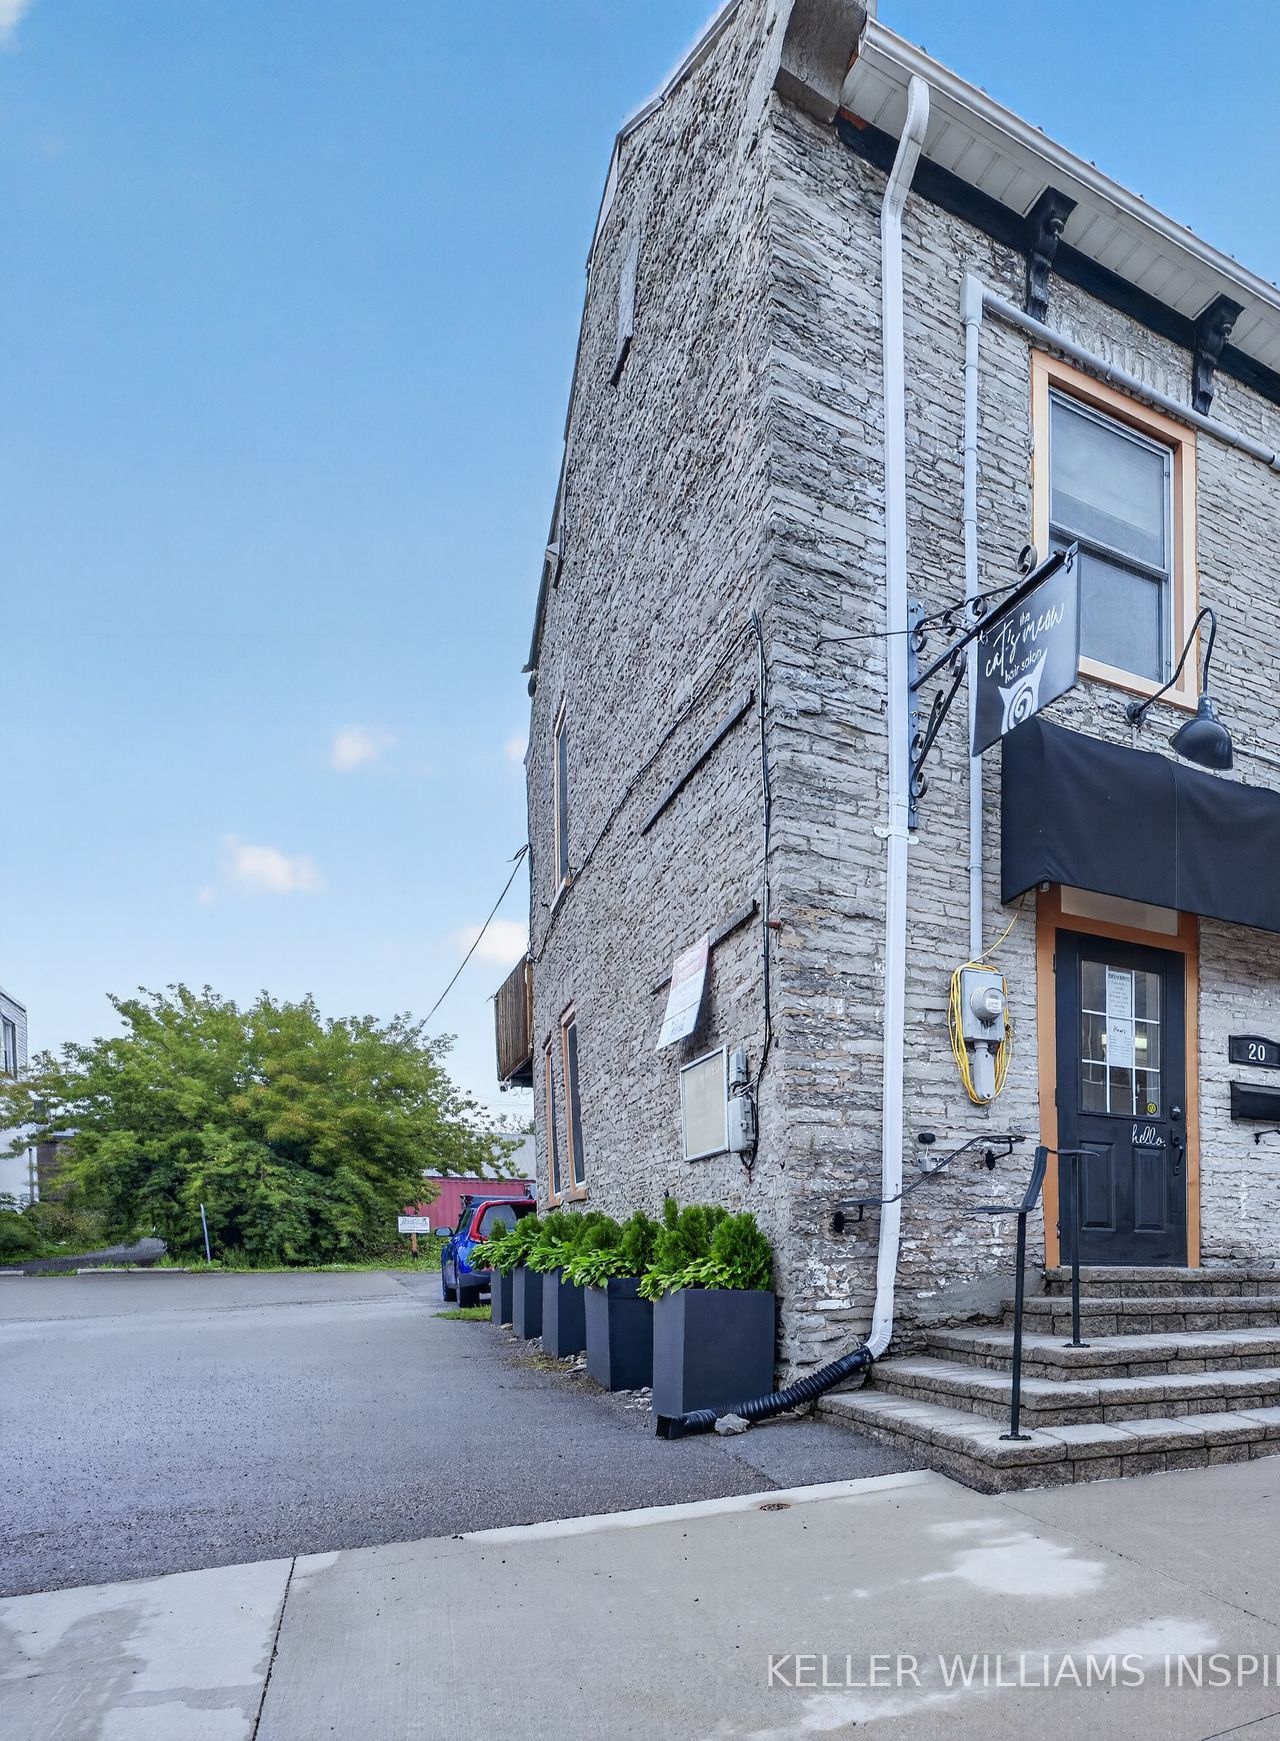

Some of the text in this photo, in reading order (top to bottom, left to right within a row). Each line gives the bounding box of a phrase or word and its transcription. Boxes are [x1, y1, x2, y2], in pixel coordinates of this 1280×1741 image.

[1023, 603, 1064, 642] meow
[1005, 648, 1042, 684] hair salon
[1248, 1043, 1266, 1061] 20
